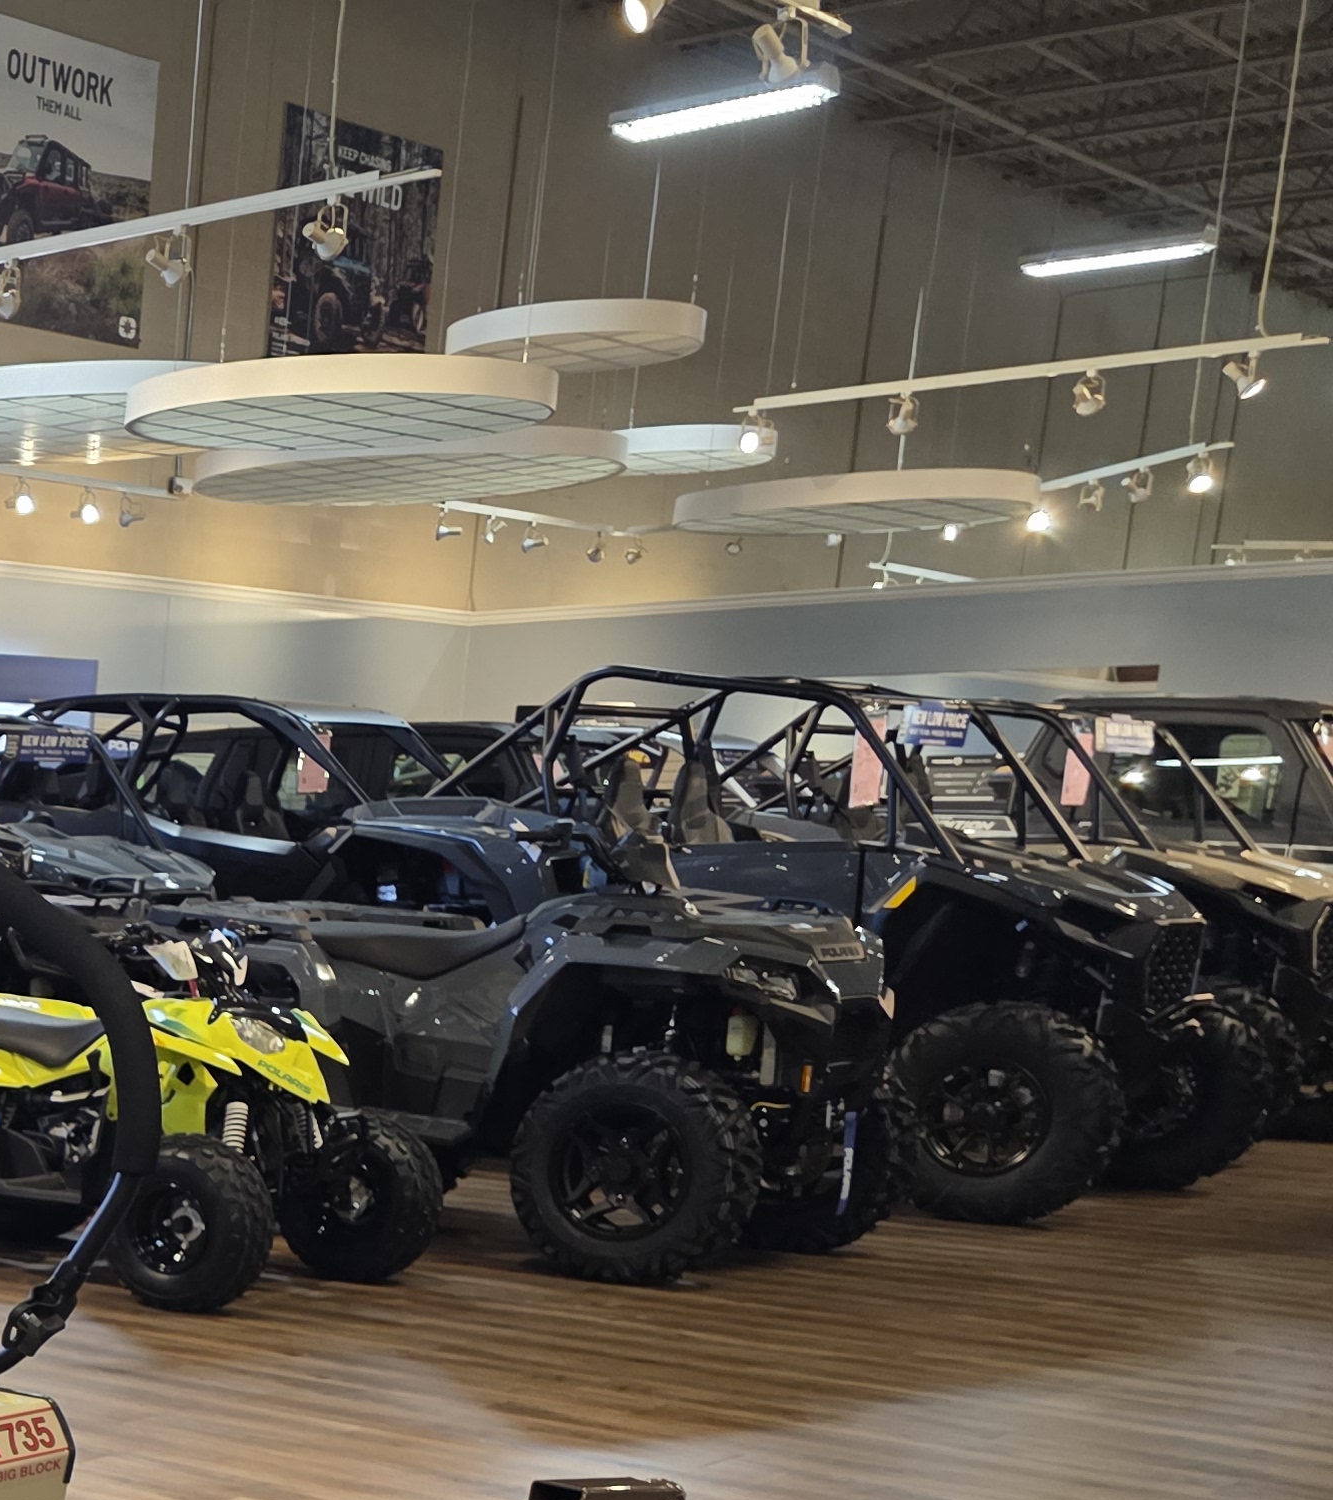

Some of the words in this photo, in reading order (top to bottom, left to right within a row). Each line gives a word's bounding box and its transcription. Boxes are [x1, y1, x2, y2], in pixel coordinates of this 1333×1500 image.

[7, 49, 113, 107] OUTWORK
[36, 95, 62, 116] THEM
[63, 104, 83, 121] ALL
[338, 145, 359, 161] KEEP
[59, 735, 89, 749] PRICE
[258, 1060, 312, 1095] POLARIS
[20, 1458, 62, 1478] BLOCK
